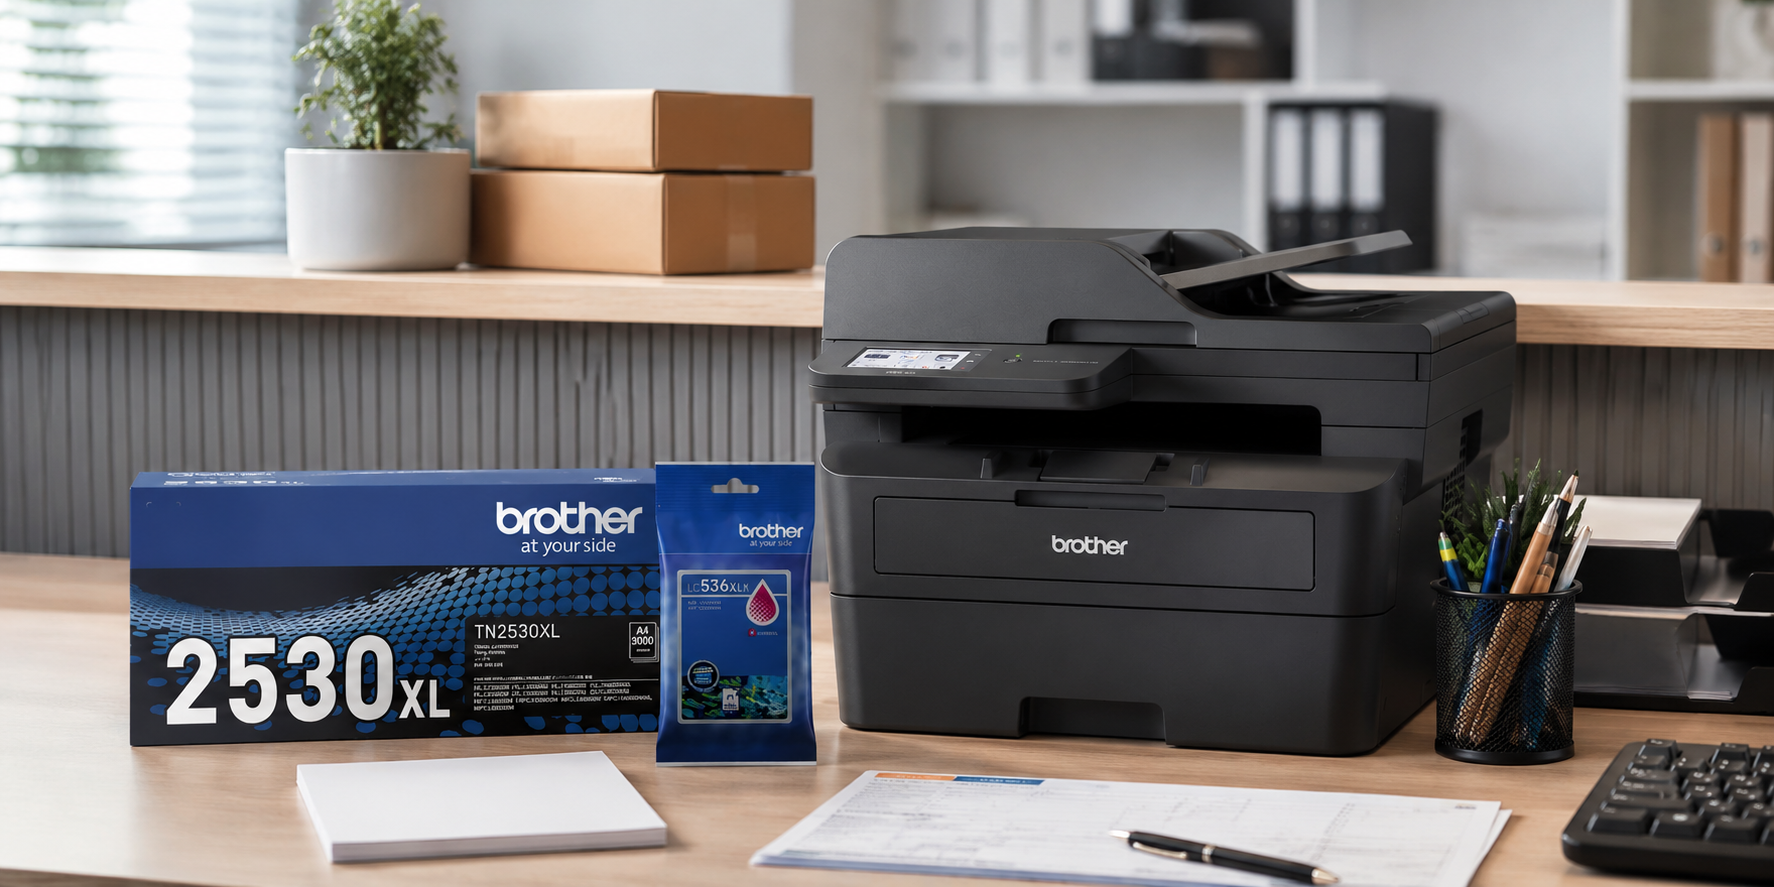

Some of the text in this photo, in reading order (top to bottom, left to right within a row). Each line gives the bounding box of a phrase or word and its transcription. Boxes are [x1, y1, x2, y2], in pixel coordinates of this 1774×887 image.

[496, 501, 643, 535] brother
[739, 523, 804, 539] brother
[521, 537, 616, 557] at your side
[759, 540, 776, 548] your
[1051, 535, 1129, 555] brother
[474, 623, 561, 640] TN2530XL
[636, 626, 649, 635] A4
[631, 636, 654, 645] 3000
